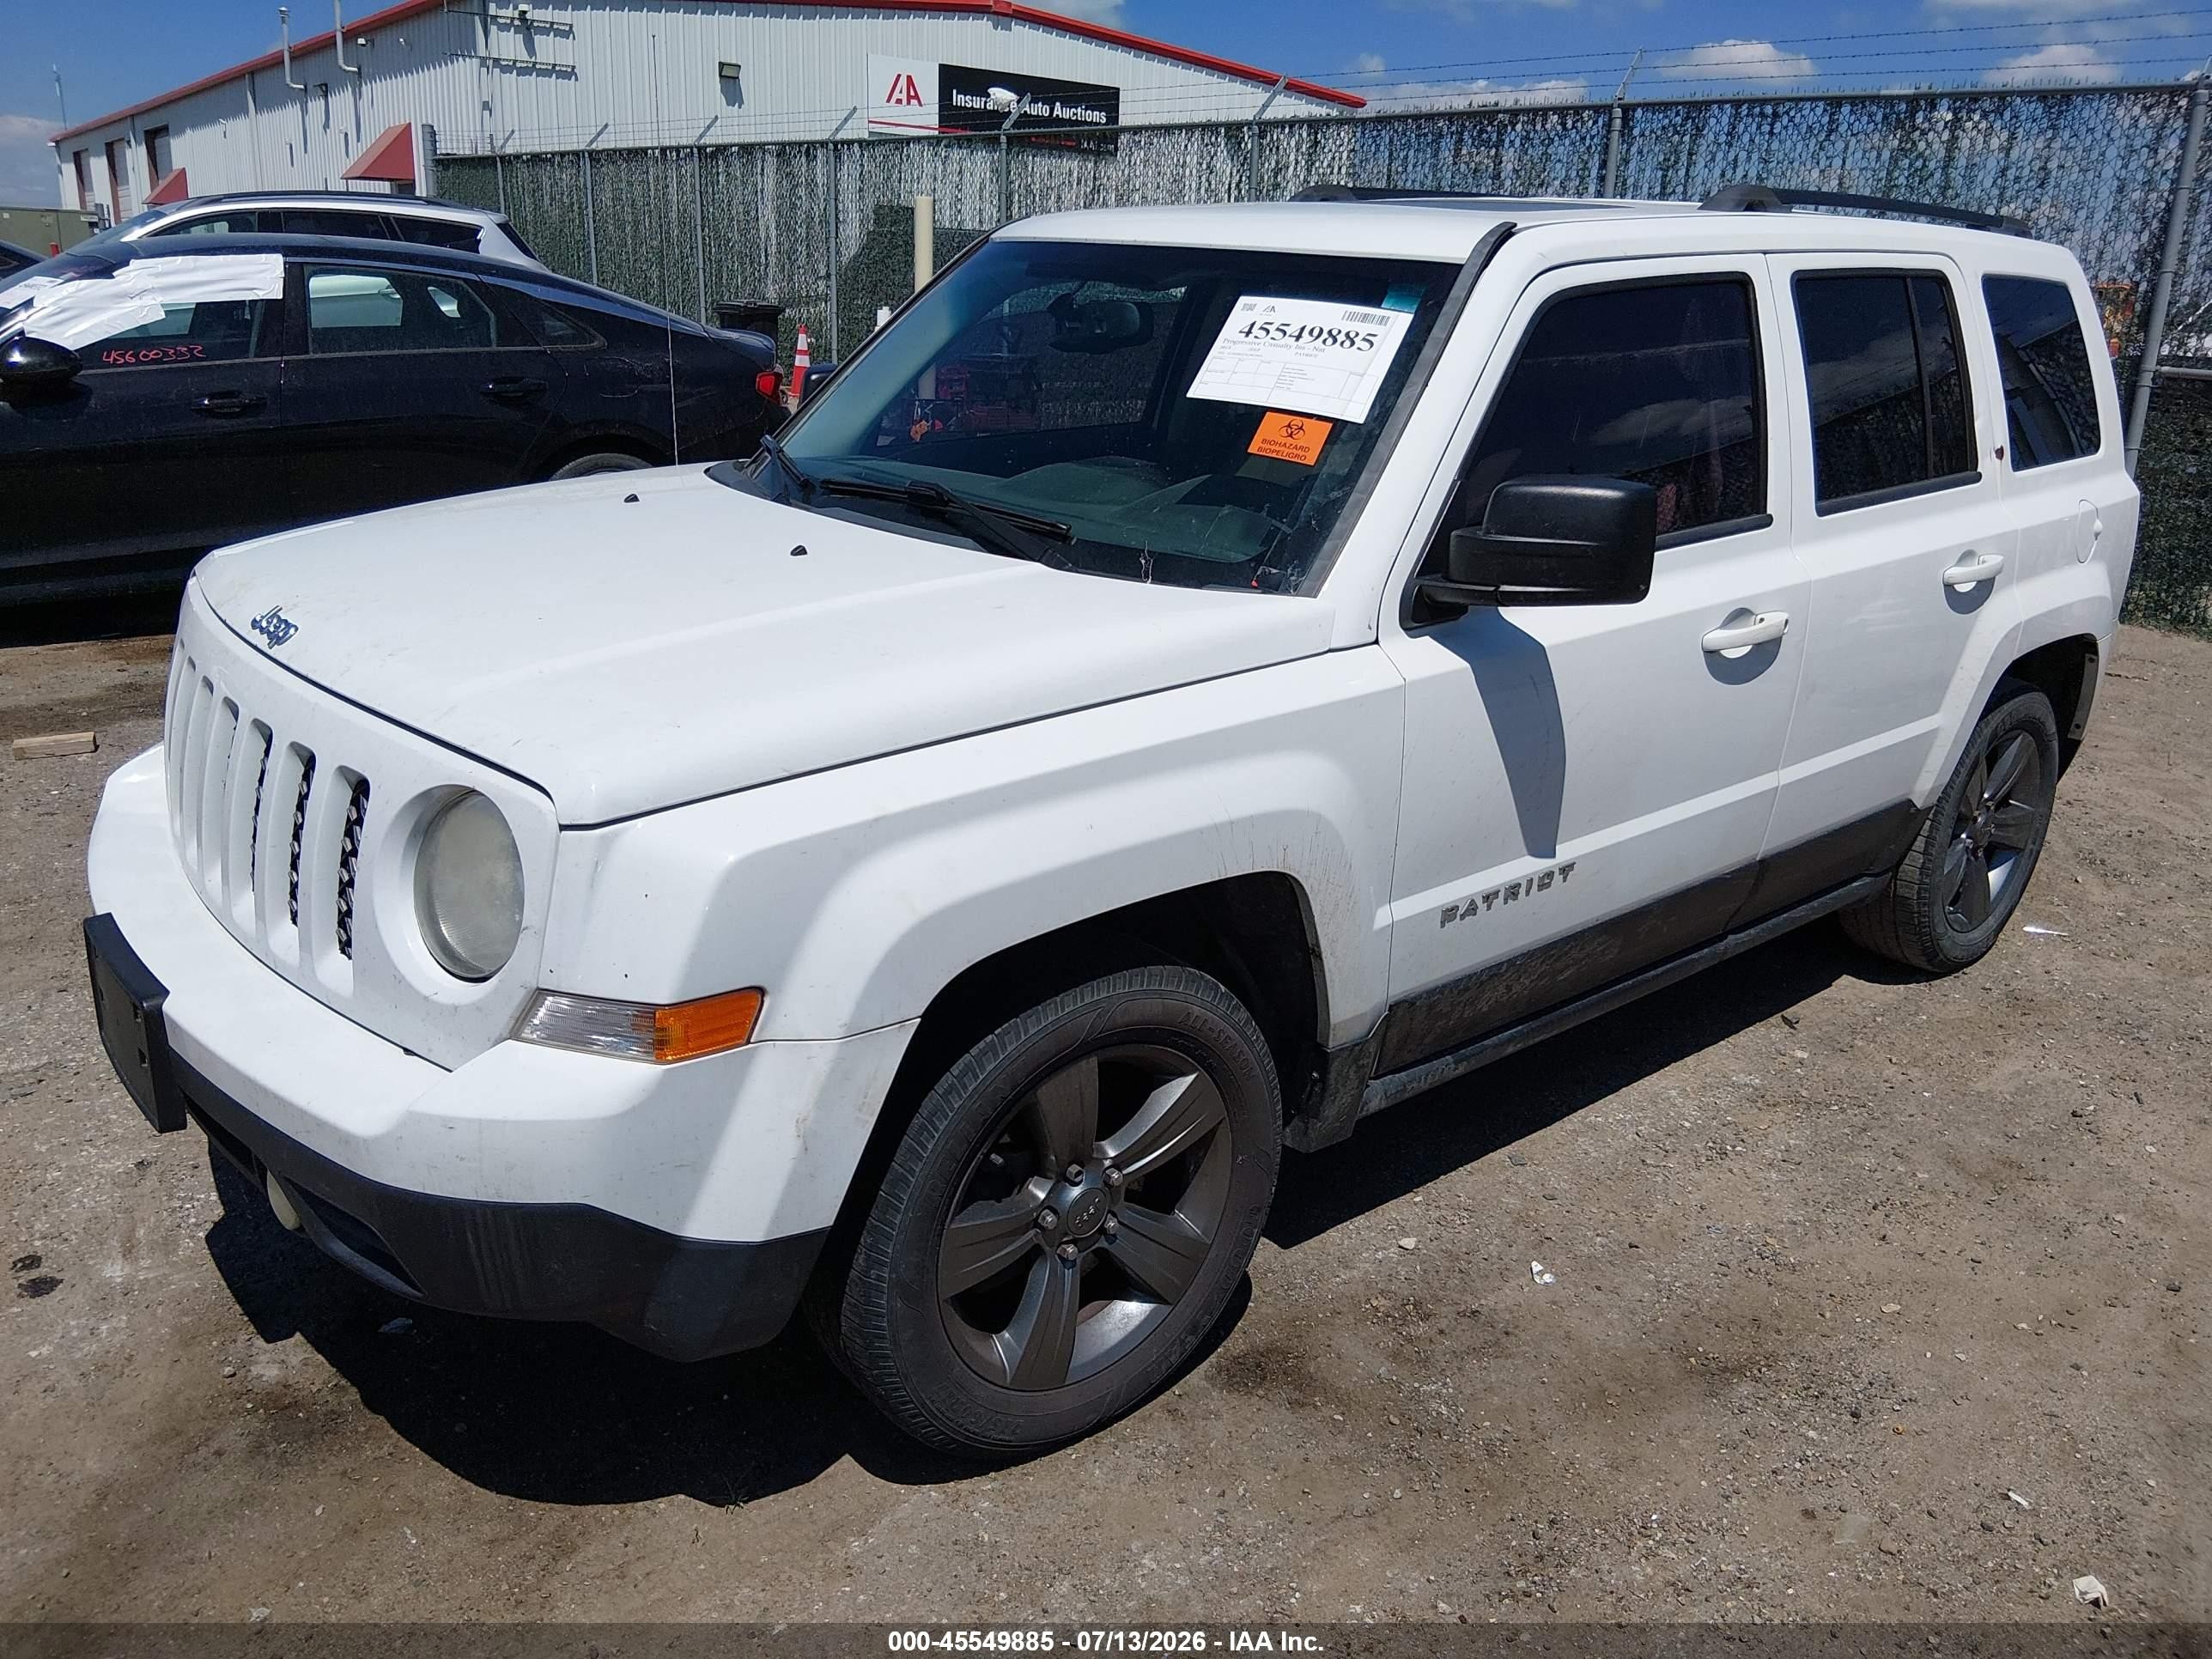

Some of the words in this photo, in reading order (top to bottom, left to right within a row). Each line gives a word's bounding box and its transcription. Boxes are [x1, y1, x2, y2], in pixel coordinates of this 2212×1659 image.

[1020, 100, 1049, 117] Auto
[1053, 102, 1107, 124] Auctions
[1238, 320, 1379, 352] 45549885
[1263, 341, 1292, 350] Casualty
[1256, 446, 1307, 461] BIOPELIGRO
[1261, 438, 1310, 453] BIOHAZARD
[251, 605, 299, 649] Jeep
[1440, 861, 1577, 929] PATRIOT
